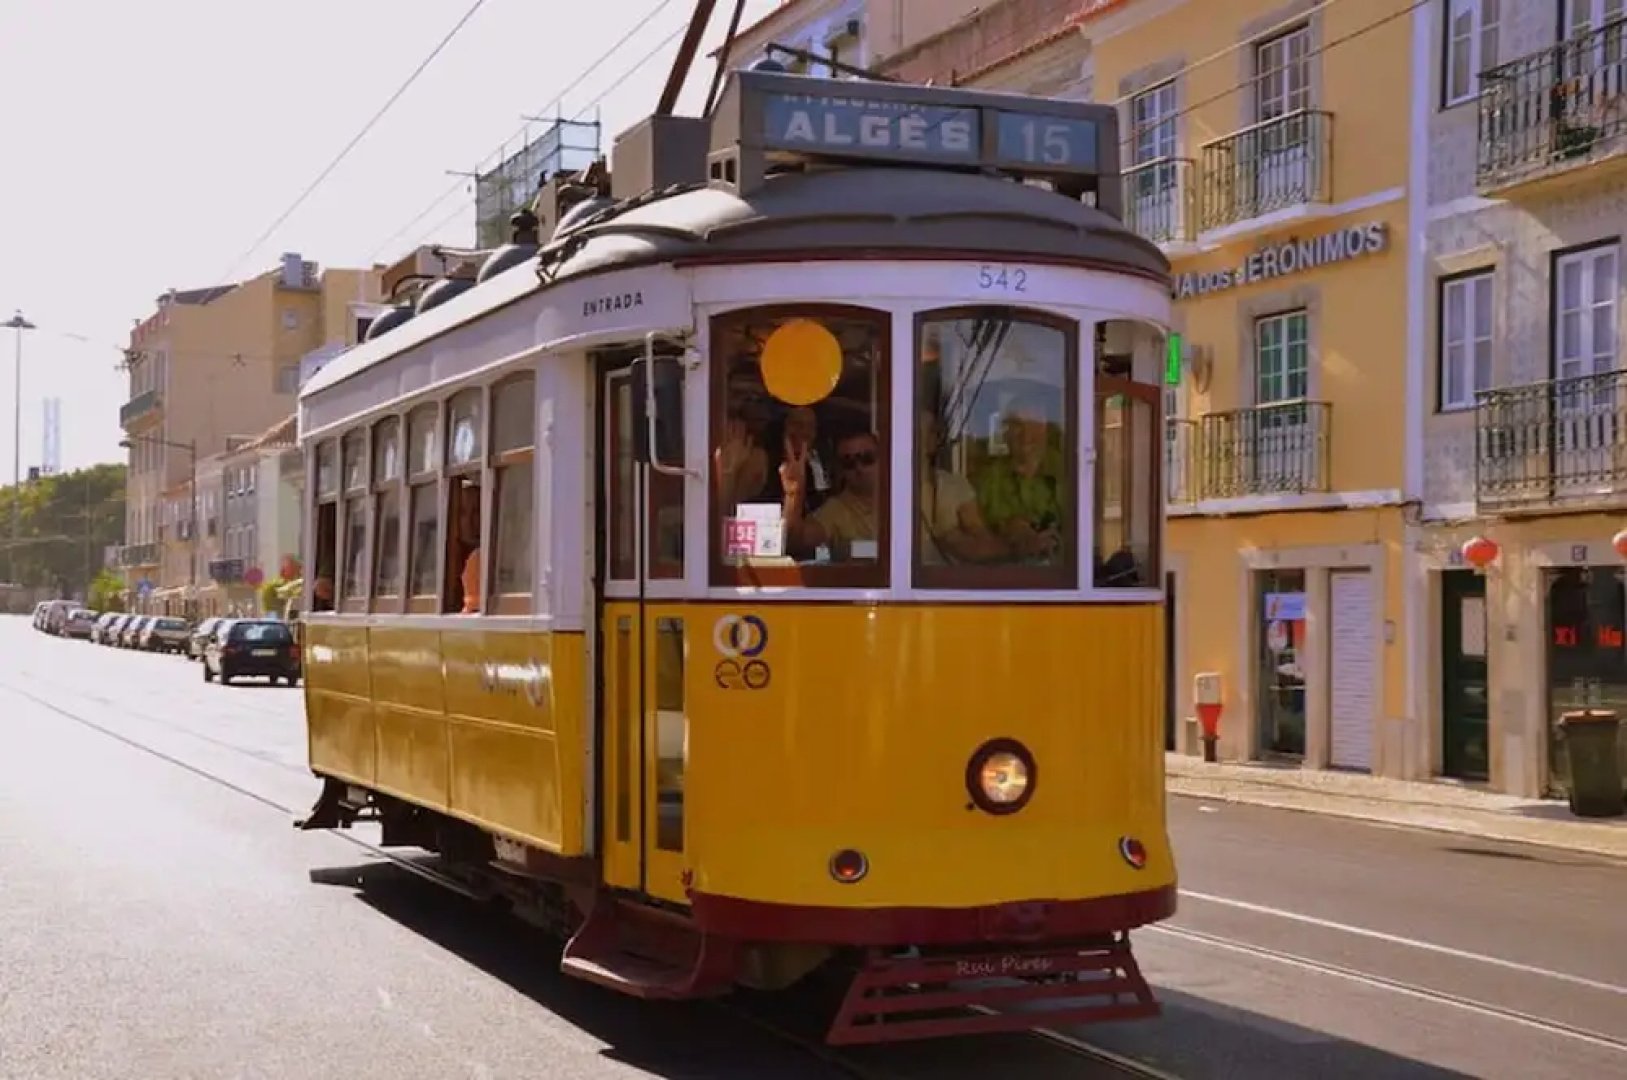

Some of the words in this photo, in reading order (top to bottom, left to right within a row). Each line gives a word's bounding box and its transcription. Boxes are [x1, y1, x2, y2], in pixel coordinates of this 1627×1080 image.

[784, 111, 970, 149] ALGÉS
[1021, 121, 1071, 164] 15
[1199, 270, 1234, 293] DOS
[1237, 221, 1386, 284] JERÓNIMOS
[979, 265, 1026, 292] 542
[583, 292, 643, 318] ENTRADA
